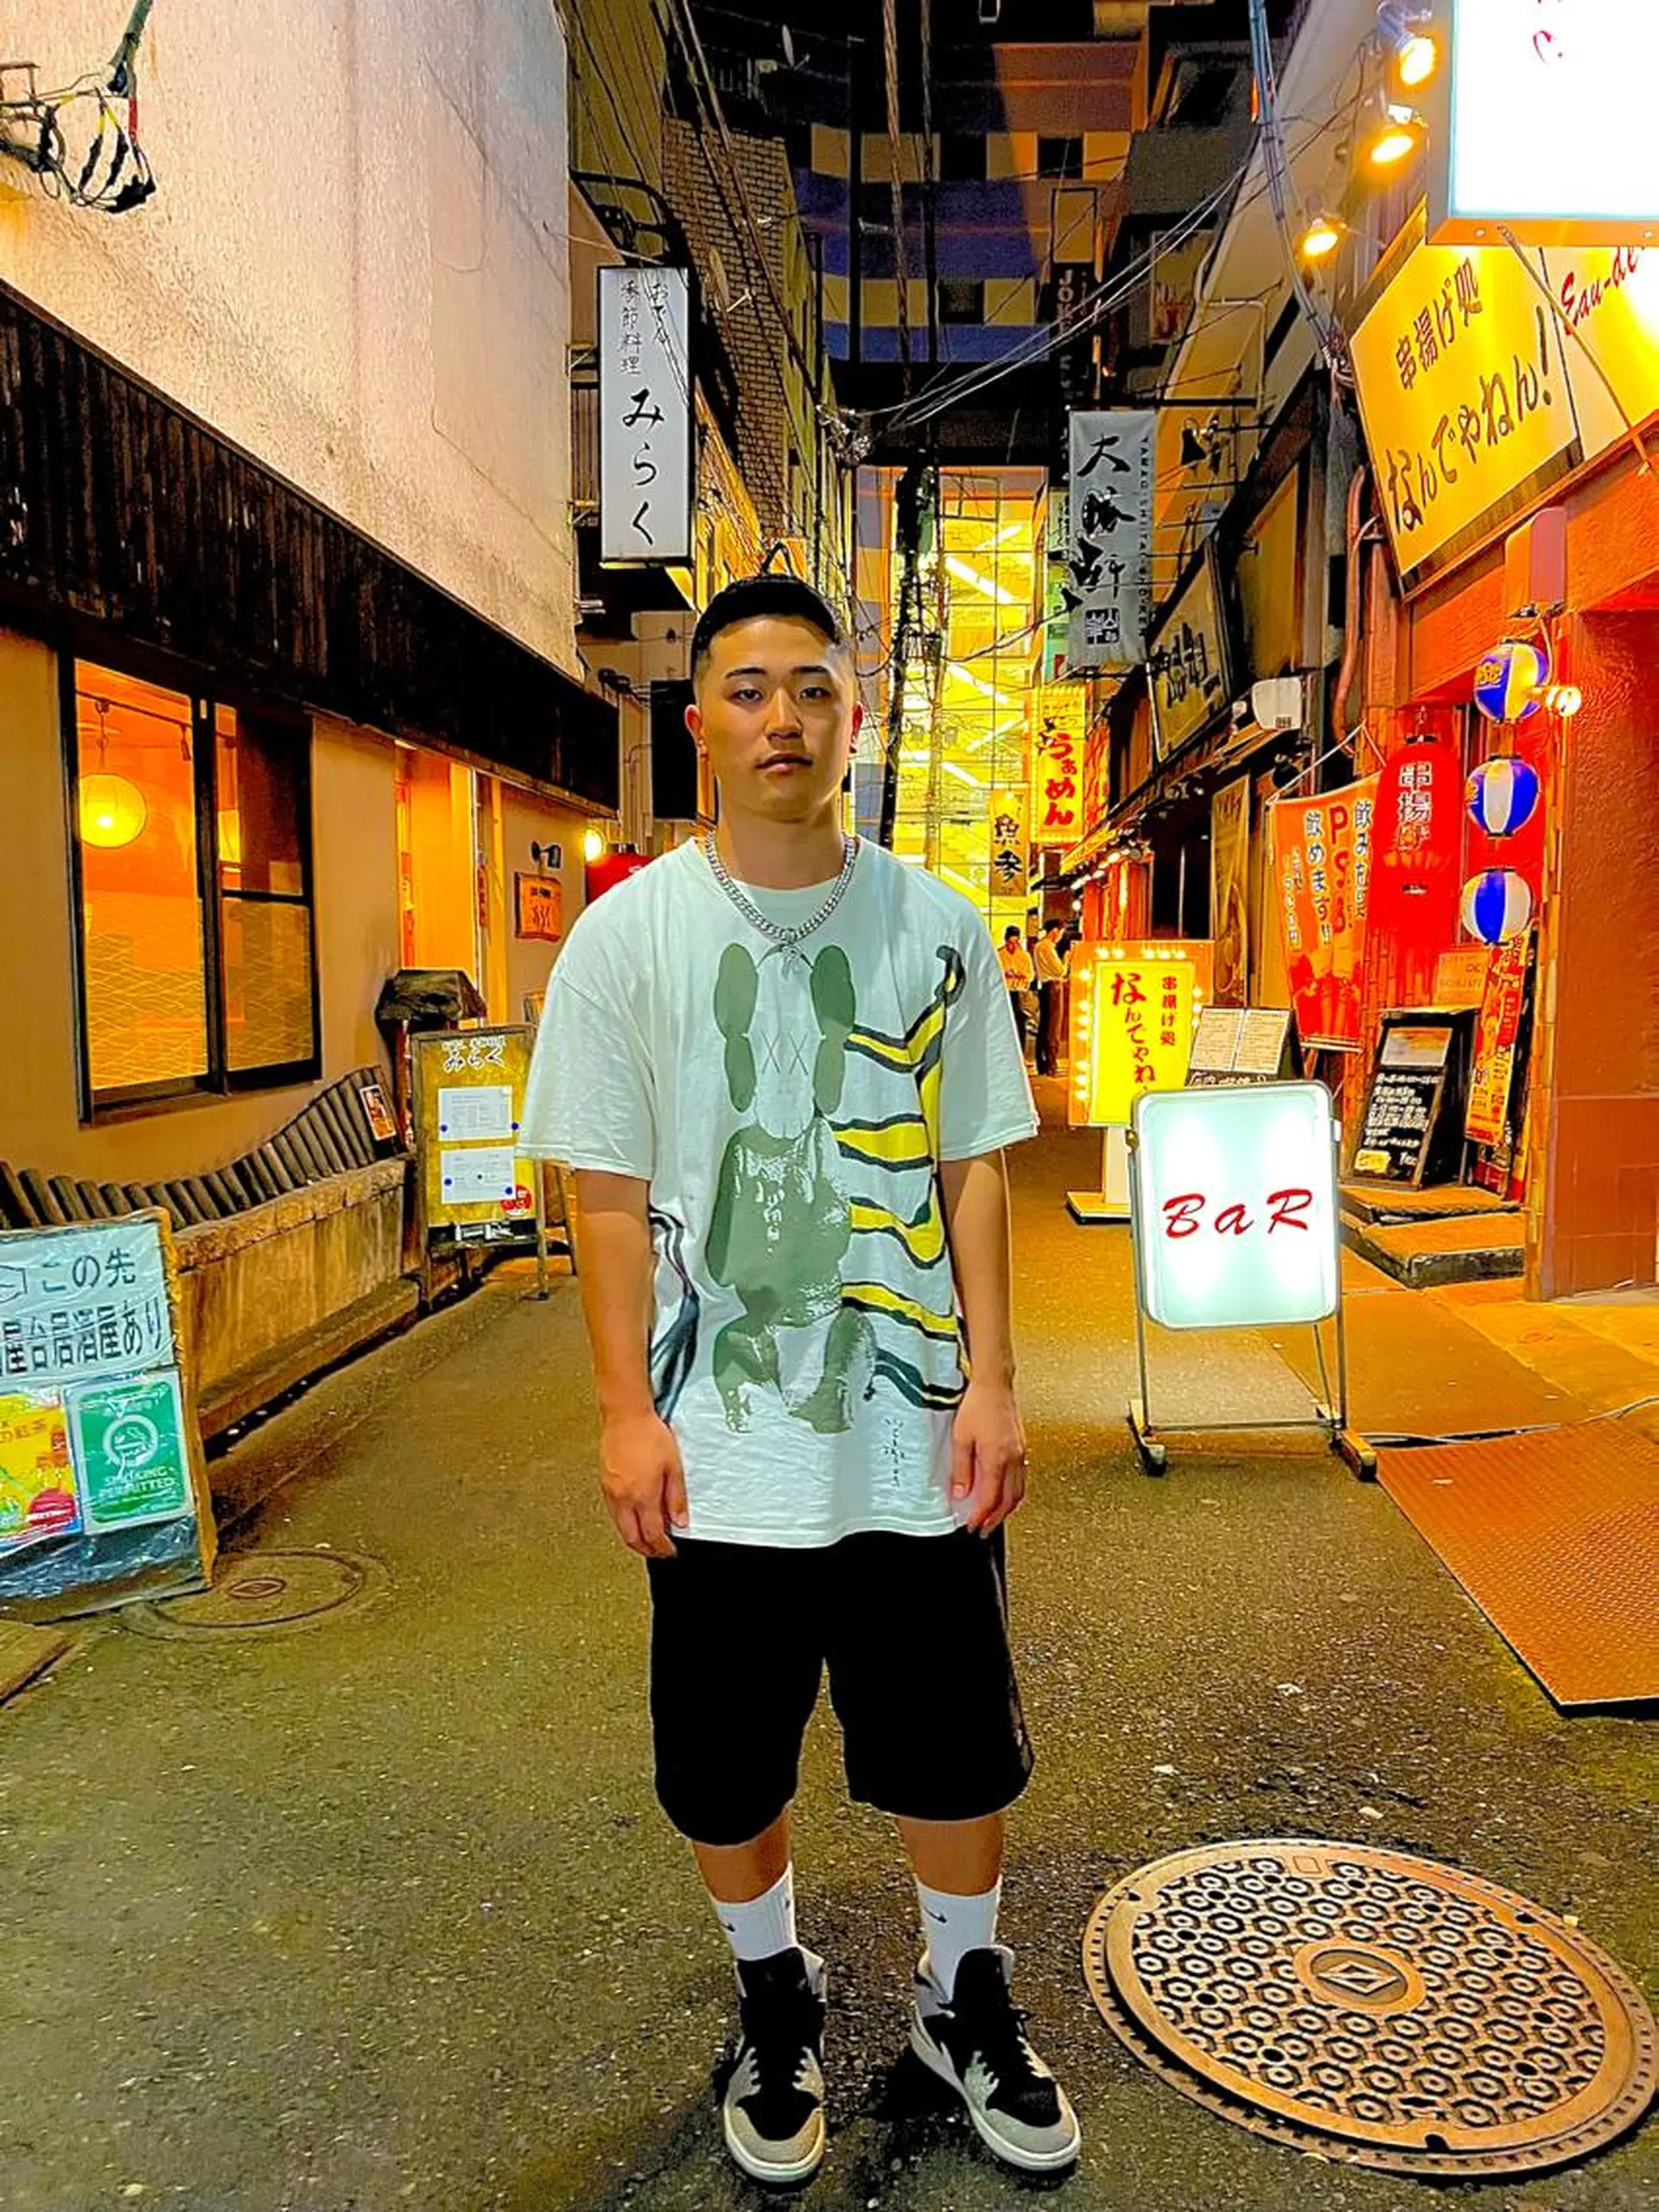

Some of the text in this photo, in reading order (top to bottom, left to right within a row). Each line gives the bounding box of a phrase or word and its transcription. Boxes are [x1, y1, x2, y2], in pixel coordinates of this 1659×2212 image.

[1395, 257, 1483, 391] 串揚げ処
[623, 389, 664, 545] みらく
[1044, 732, 1078, 827] らぁめん
[41, 1248, 137, 1294] この先
[0, 1296, 162, 1376] 屋台居酒屋あり
